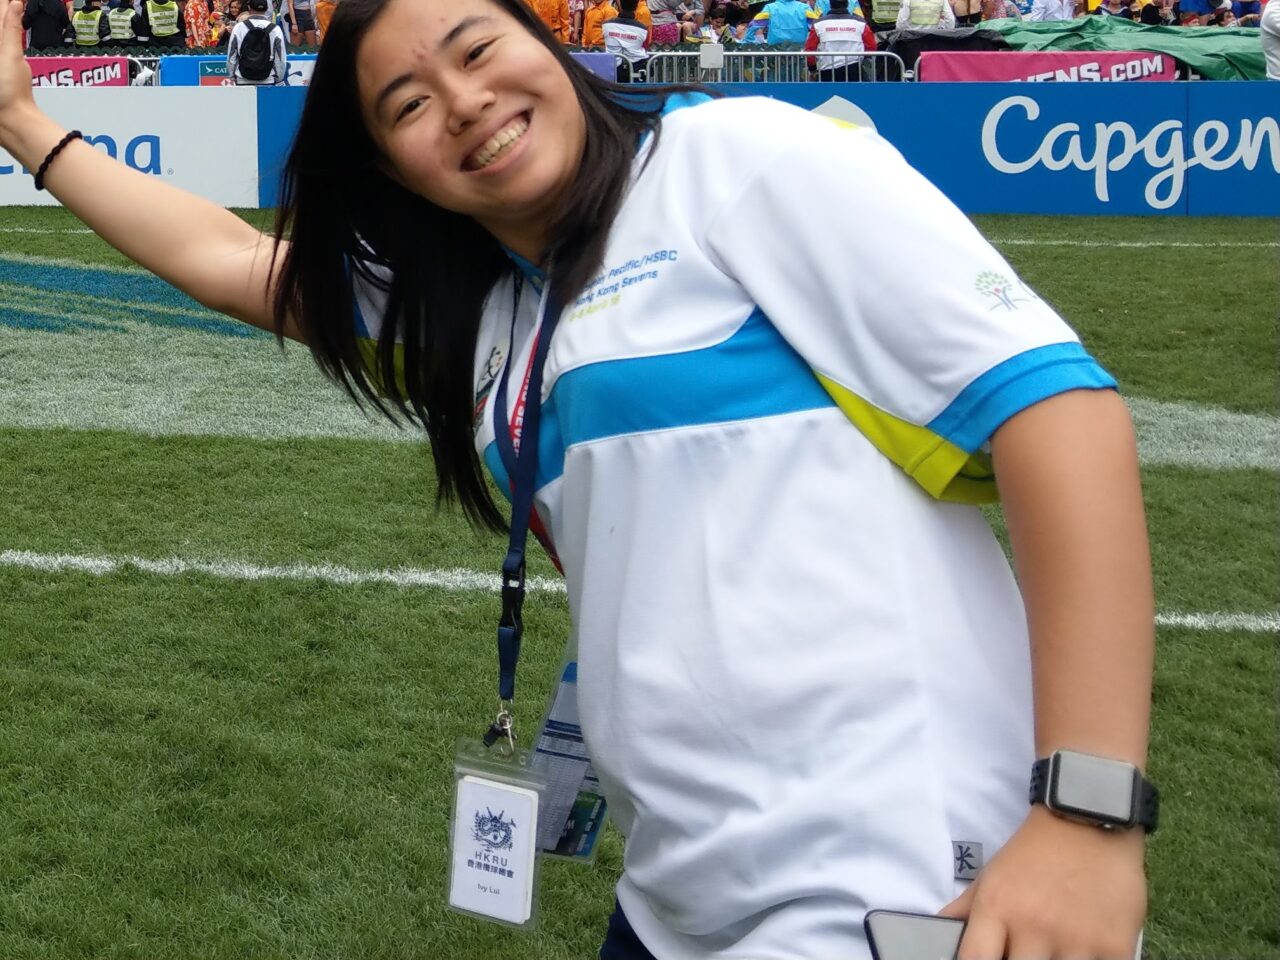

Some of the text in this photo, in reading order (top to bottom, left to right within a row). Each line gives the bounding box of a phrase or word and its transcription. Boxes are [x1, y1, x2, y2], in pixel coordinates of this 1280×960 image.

[609, 250, 678, 277] Pacific/HSBC
[597, 283, 620, 297] Kong
[622, 270, 658, 288] Sevens
[475, 850, 508, 867] HKRU
[489, 886, 500, 895] Lui
